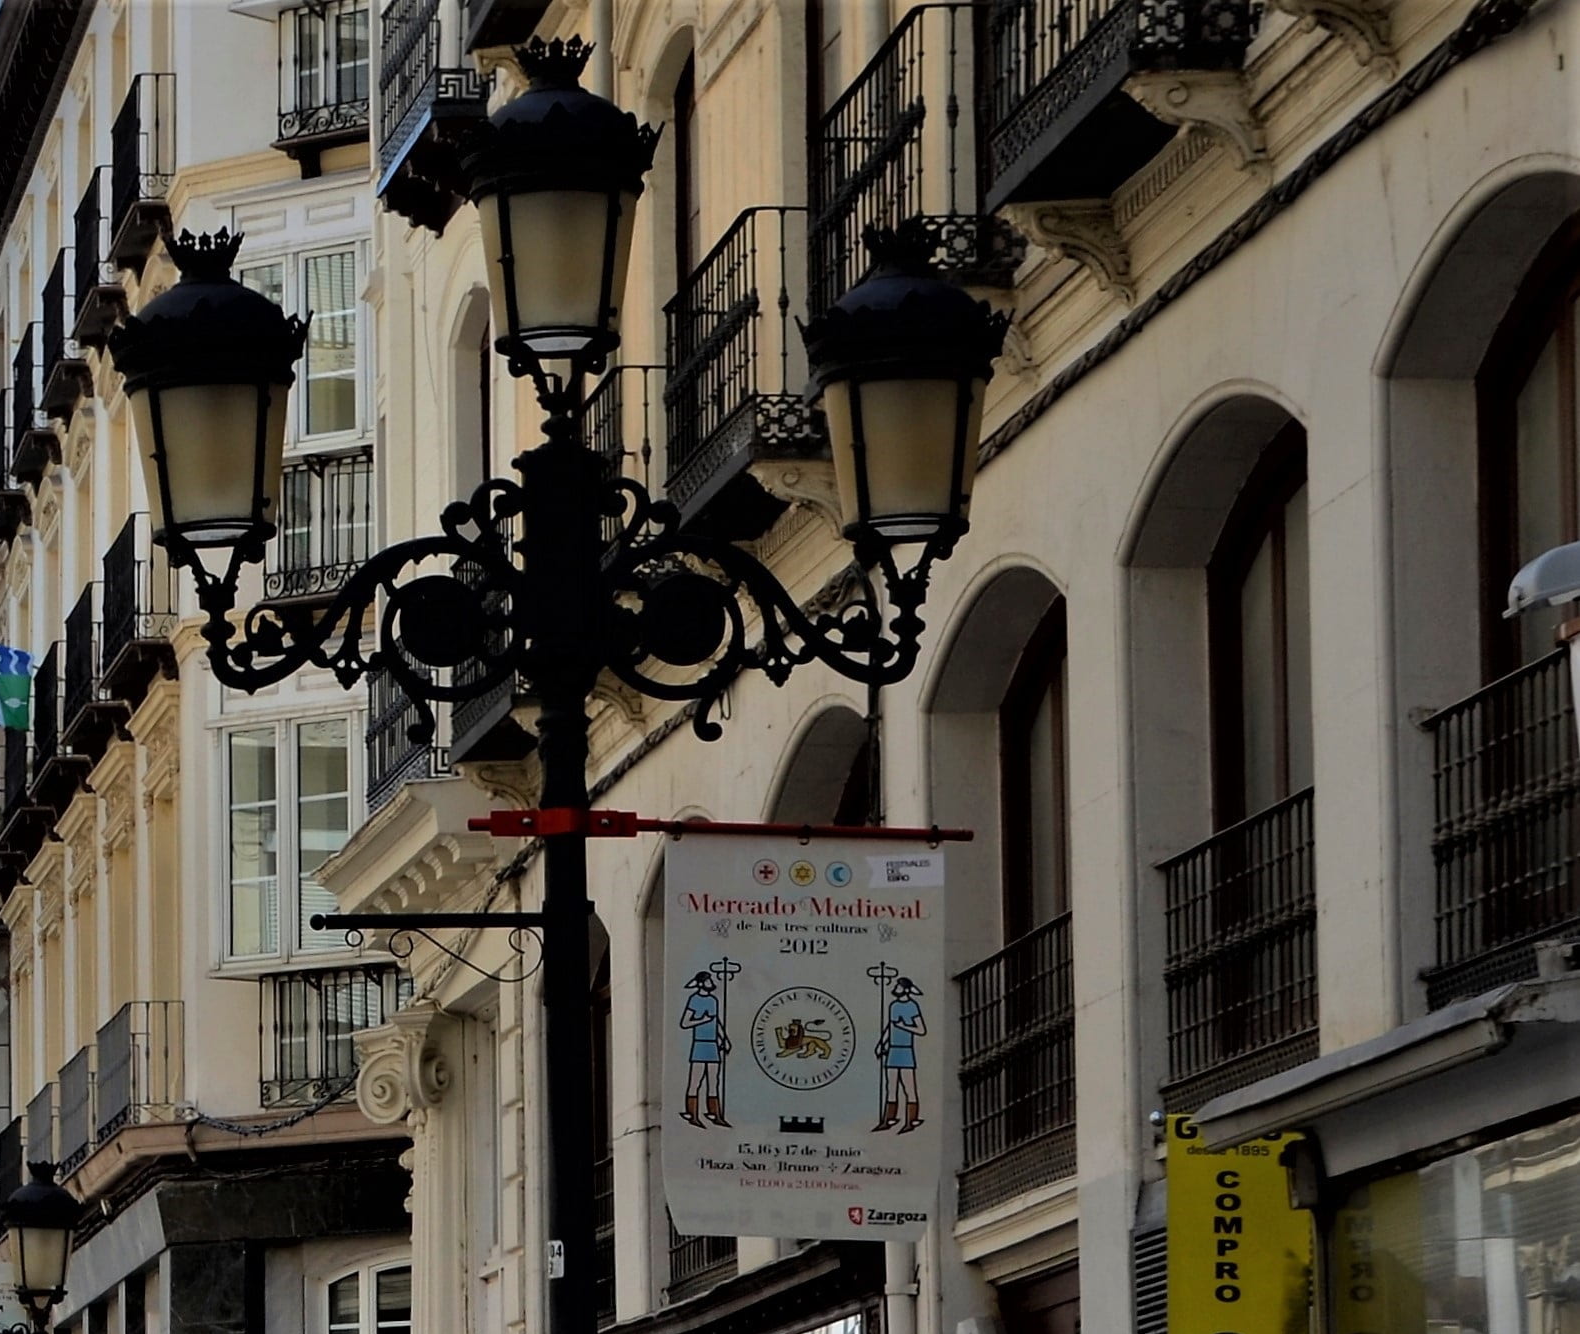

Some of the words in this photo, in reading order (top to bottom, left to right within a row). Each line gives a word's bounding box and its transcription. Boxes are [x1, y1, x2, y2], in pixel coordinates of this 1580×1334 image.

[681, 893, 797, 917] Mercado
[803, 896, 927, 920] Medieval
[736, 921, 752, 931] de
[760, 921, 778, 932] las
[785, 922, 808, 933] tres
[815, 923, 868, 935] culturas
[779, 938, 828, 955] 2012
[738, 1143, 755, 1157] 15,
[758, 1144, 772, 1156] 16
[785, 1145, 798, 1157] 17
[801, 1146, 816, 1157] de
[825, 1146, 862, 1159] Junio
[1236, 1145, 1269, 1157] 1895
[698, 1158, 734, 1171] Plaza
[742, 1160, 767, 1172] San
[778, 1160, 820, 1173] Bruno
[842, 1162, 903, 1176] Zaragoza
[740, 1178, 755, 1188] De
[867, 1209, 927, 1225] Zaragoza
[1214, 1171, 1242, 1303] COMPRO
